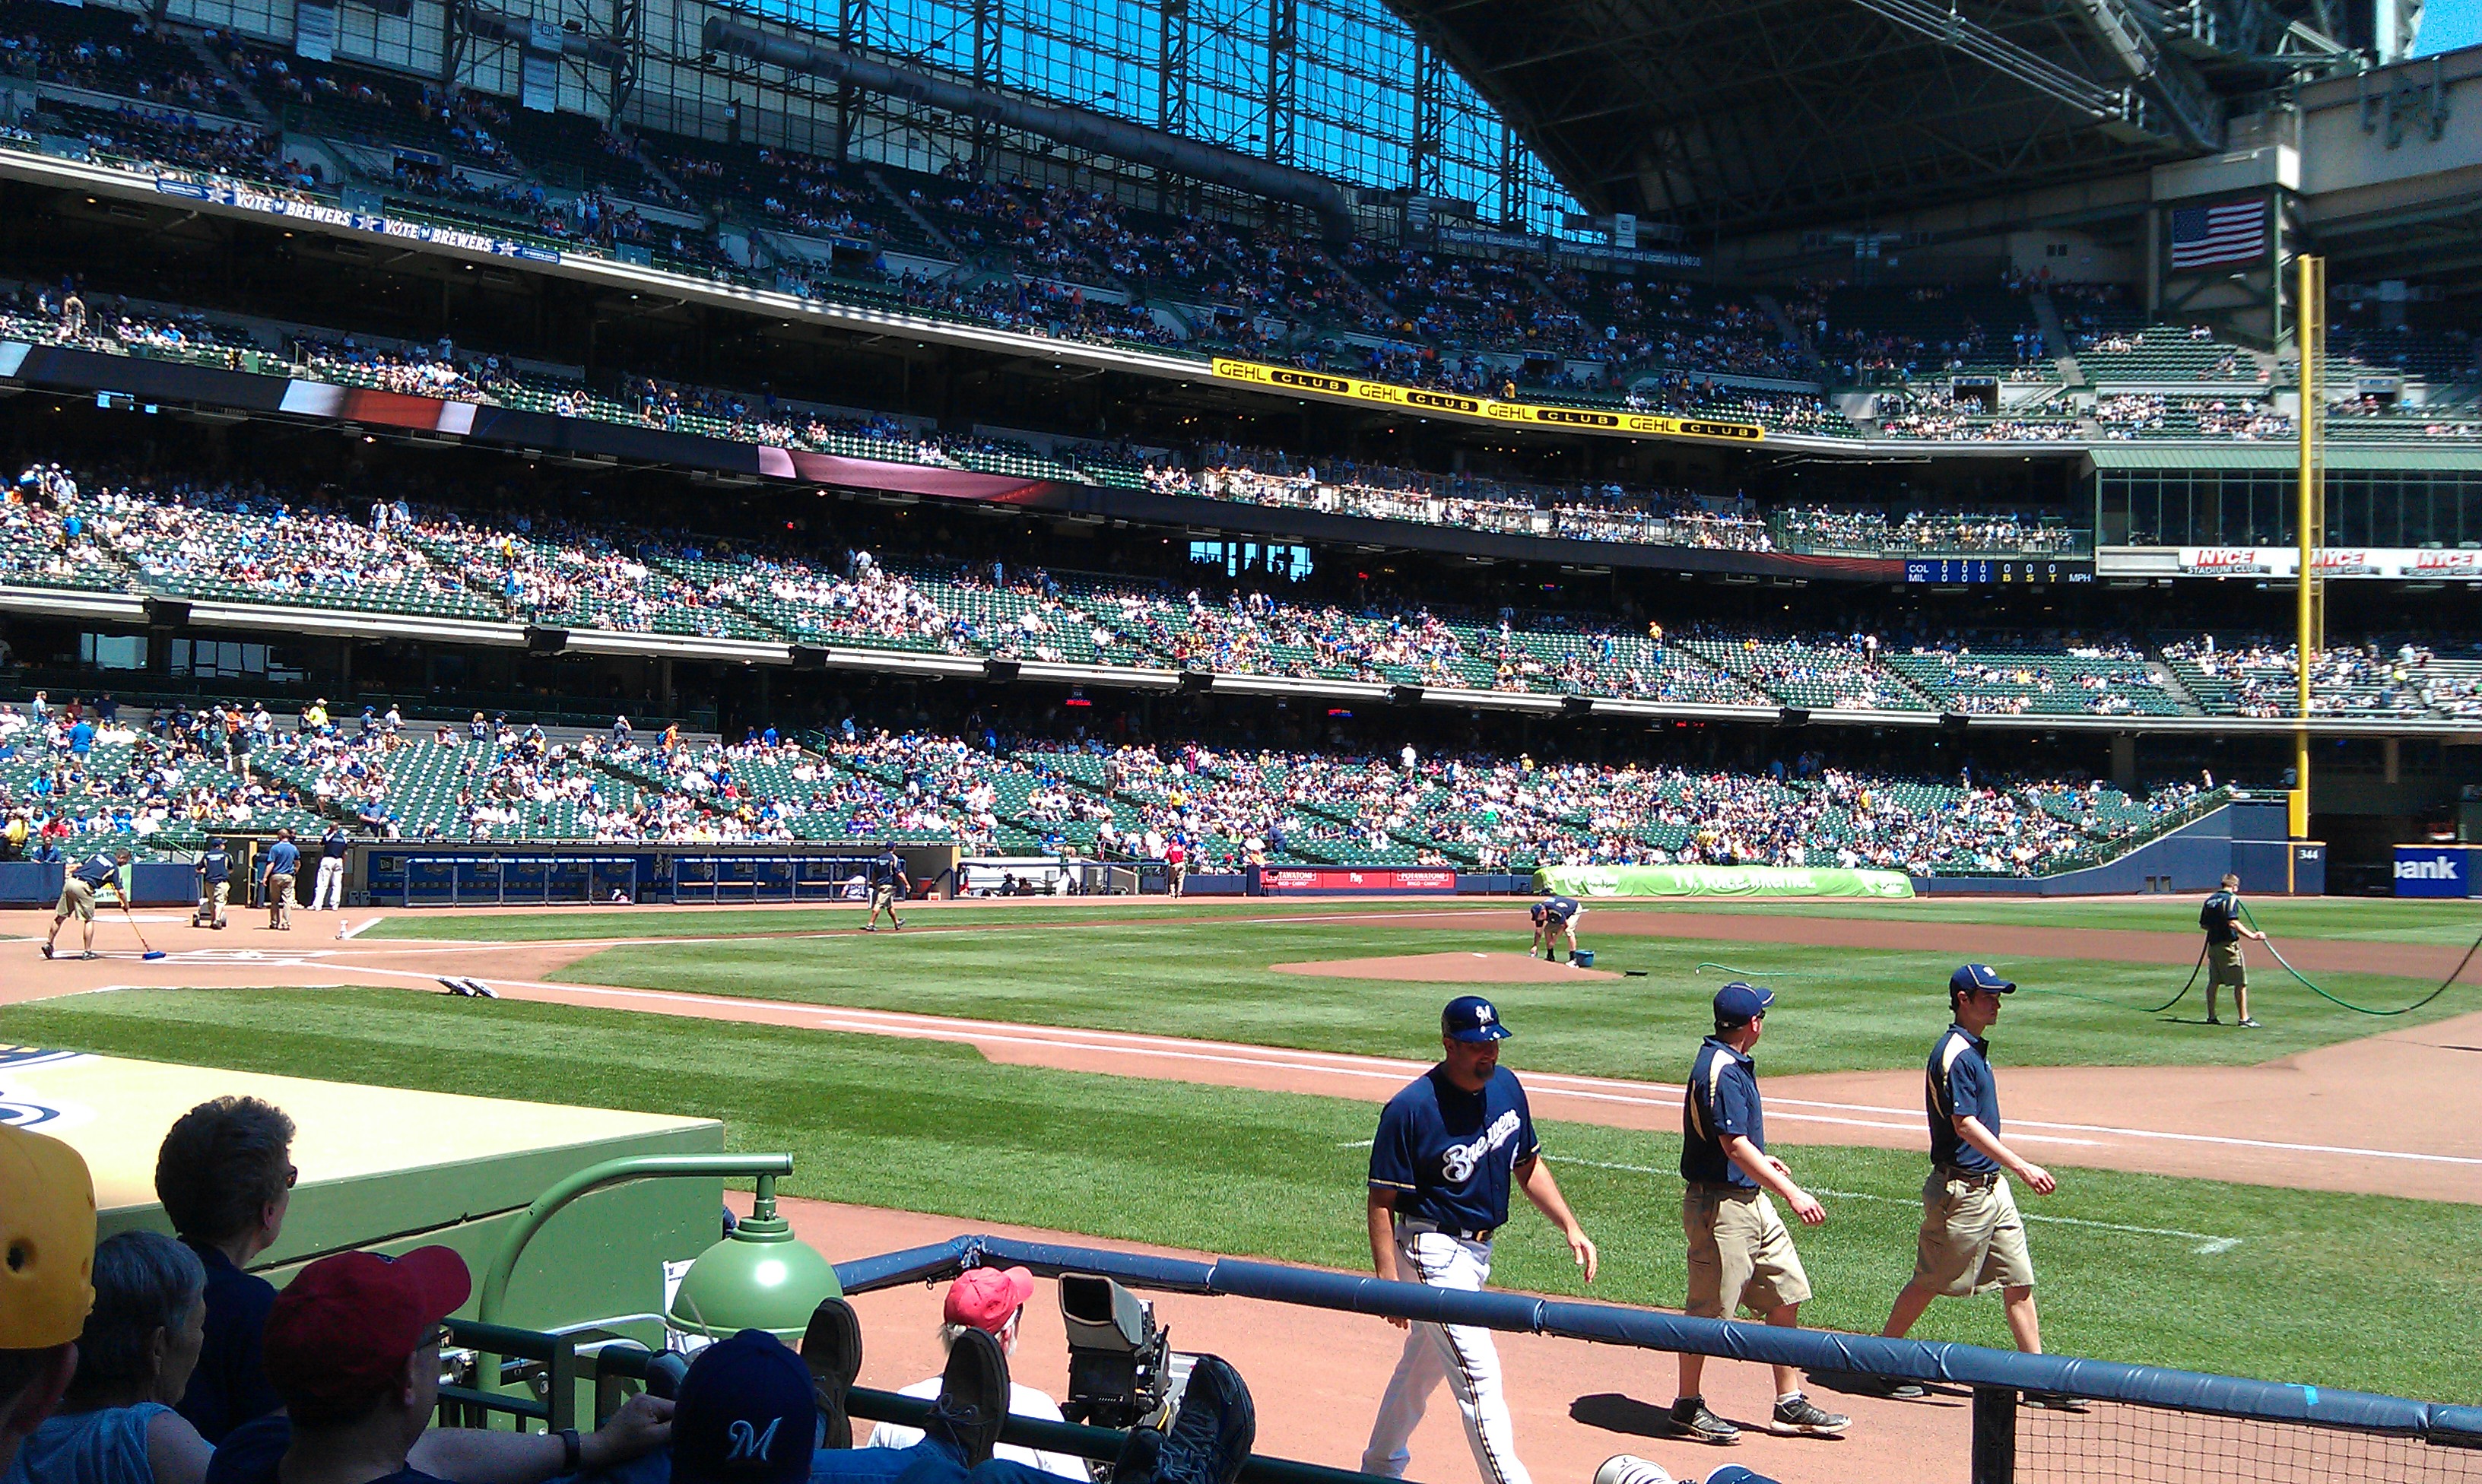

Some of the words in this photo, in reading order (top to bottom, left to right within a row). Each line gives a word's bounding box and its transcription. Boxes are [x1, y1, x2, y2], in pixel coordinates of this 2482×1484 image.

[235, 192, 272, 212] VOTE
[286, 201, 351, 227] BREWERS
[384, 218, 418, 239] VOTE
[431, 227, 493, 252] BREWERS
[1219, 362, 1267, 381] GEHL
[1281, 373, 1340, 391] CLUB
[1360, 384, 1403, 402] GEHL
[1416, 394, 1470, 411] CLUB
[1487, 404, 1533, 420] GEHL
[1547, 411, 1608, 425] CLUB
[1630, 417, 1676, 433] GEHL
[1690, 424, 1749, 437] CLUB
[1909, 564, 1929, 573] COL
[1941, 564, 1948, 573] 0
[1962, 564, 1968, 573] 0
[1980, 564, 1986, 573] 0
[2004, 563, 2011, 573] 0
[2026, 563, 2033, 573] 0
[2048, 563, 2056, 573] 0
[2197, 550, 2256, 566] NYCE
[1908, 574, 1925, 582] MIL
[1941, 574, 1948, 582] 0
[1962, 574, 1968, 582] 0
[1980, 574, 1986, 582] 0
[2003, 573, 2012, 582] B
[2026, 573, 2035, 582] S
[2048, 573, 2057, 582] T
[2068, 573, 2092, 582] MPH
[2187, 566, 2233, 575] STADIUM
[2234, 564, 2261, 573] CLUB
[2298, 848, 2319, 860] 344
[1442, 1108, 1521, 1183] Brewers
[727, 1416, 782, 1461] M
